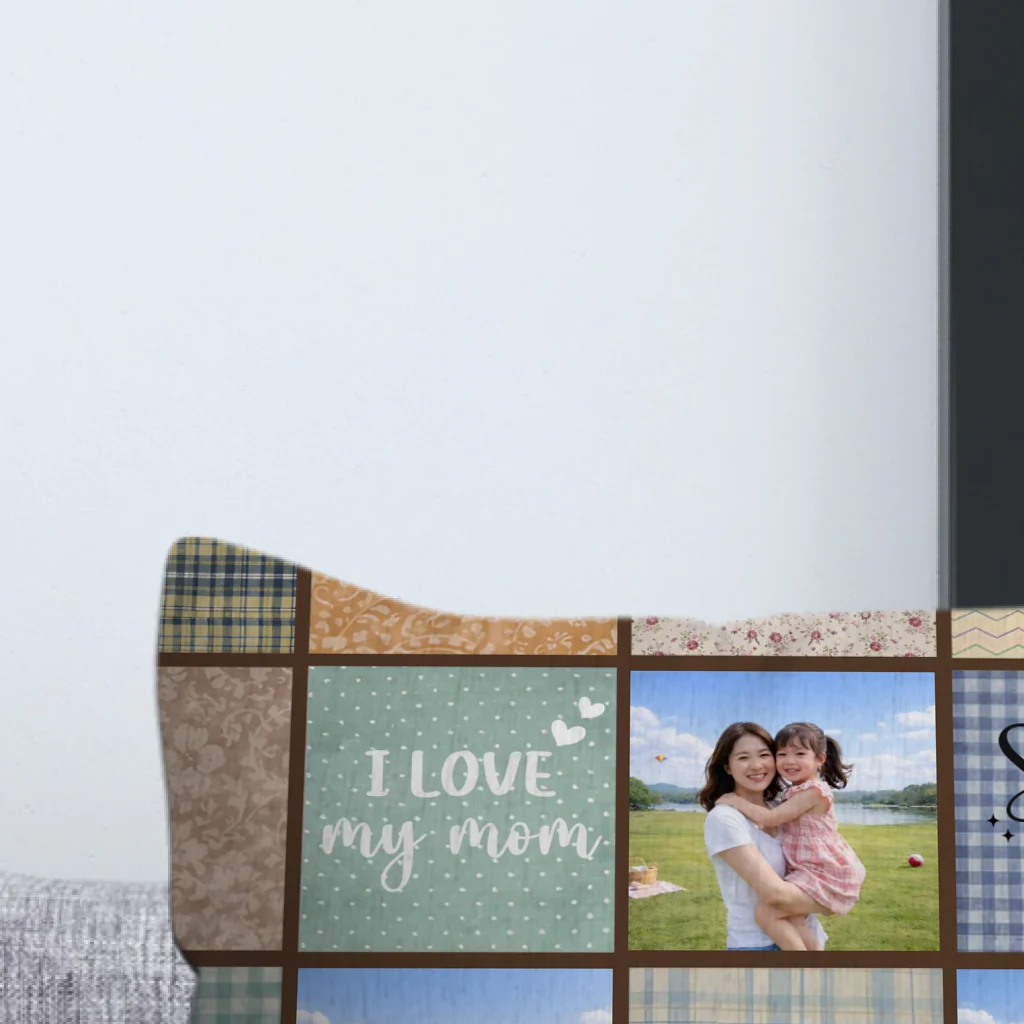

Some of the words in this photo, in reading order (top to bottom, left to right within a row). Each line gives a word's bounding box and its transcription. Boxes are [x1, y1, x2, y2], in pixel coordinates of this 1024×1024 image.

[364, 749, 390, 797] I
[410, 749, 557, 798] LOVE
[322, 816, 427, 893] my
[449, 816, 603, 859] mom
